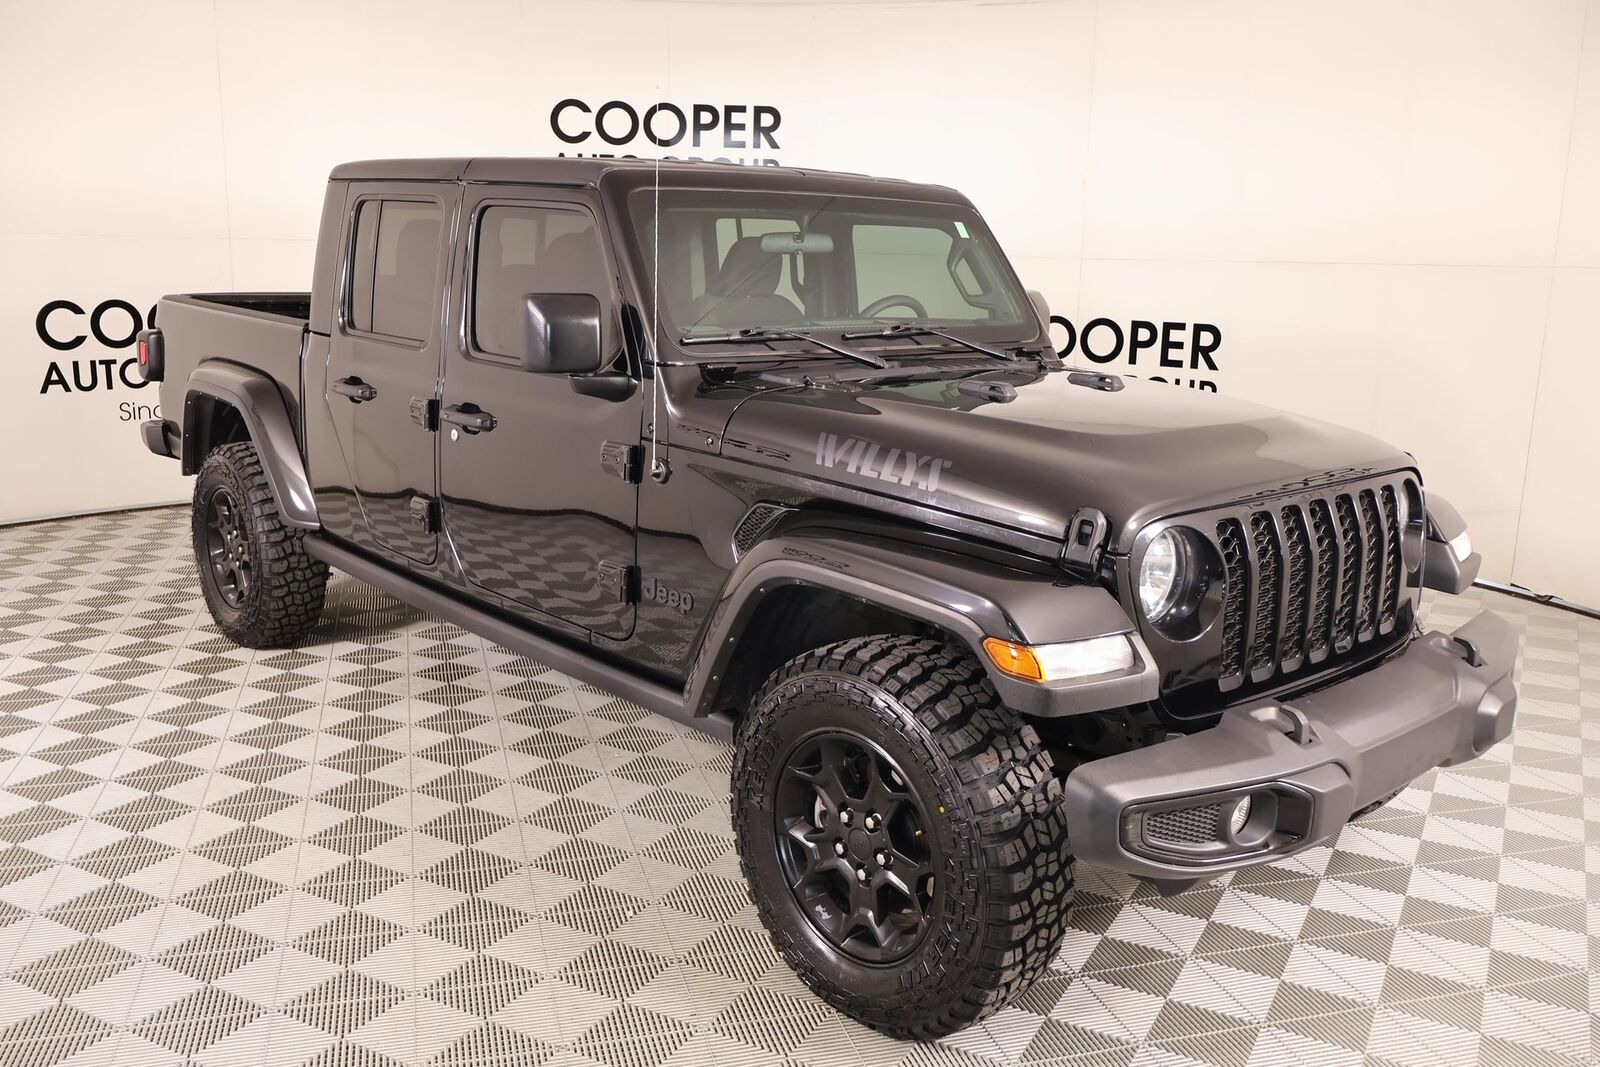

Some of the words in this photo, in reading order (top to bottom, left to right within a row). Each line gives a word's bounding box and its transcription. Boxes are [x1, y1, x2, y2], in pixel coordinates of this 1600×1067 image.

[550, 98, 782, 150] COOPER
[36, 299, 158, 351] CO
[815, 432, 952, 492] WILLYS
[642, 576, 694, 615] Jeep
